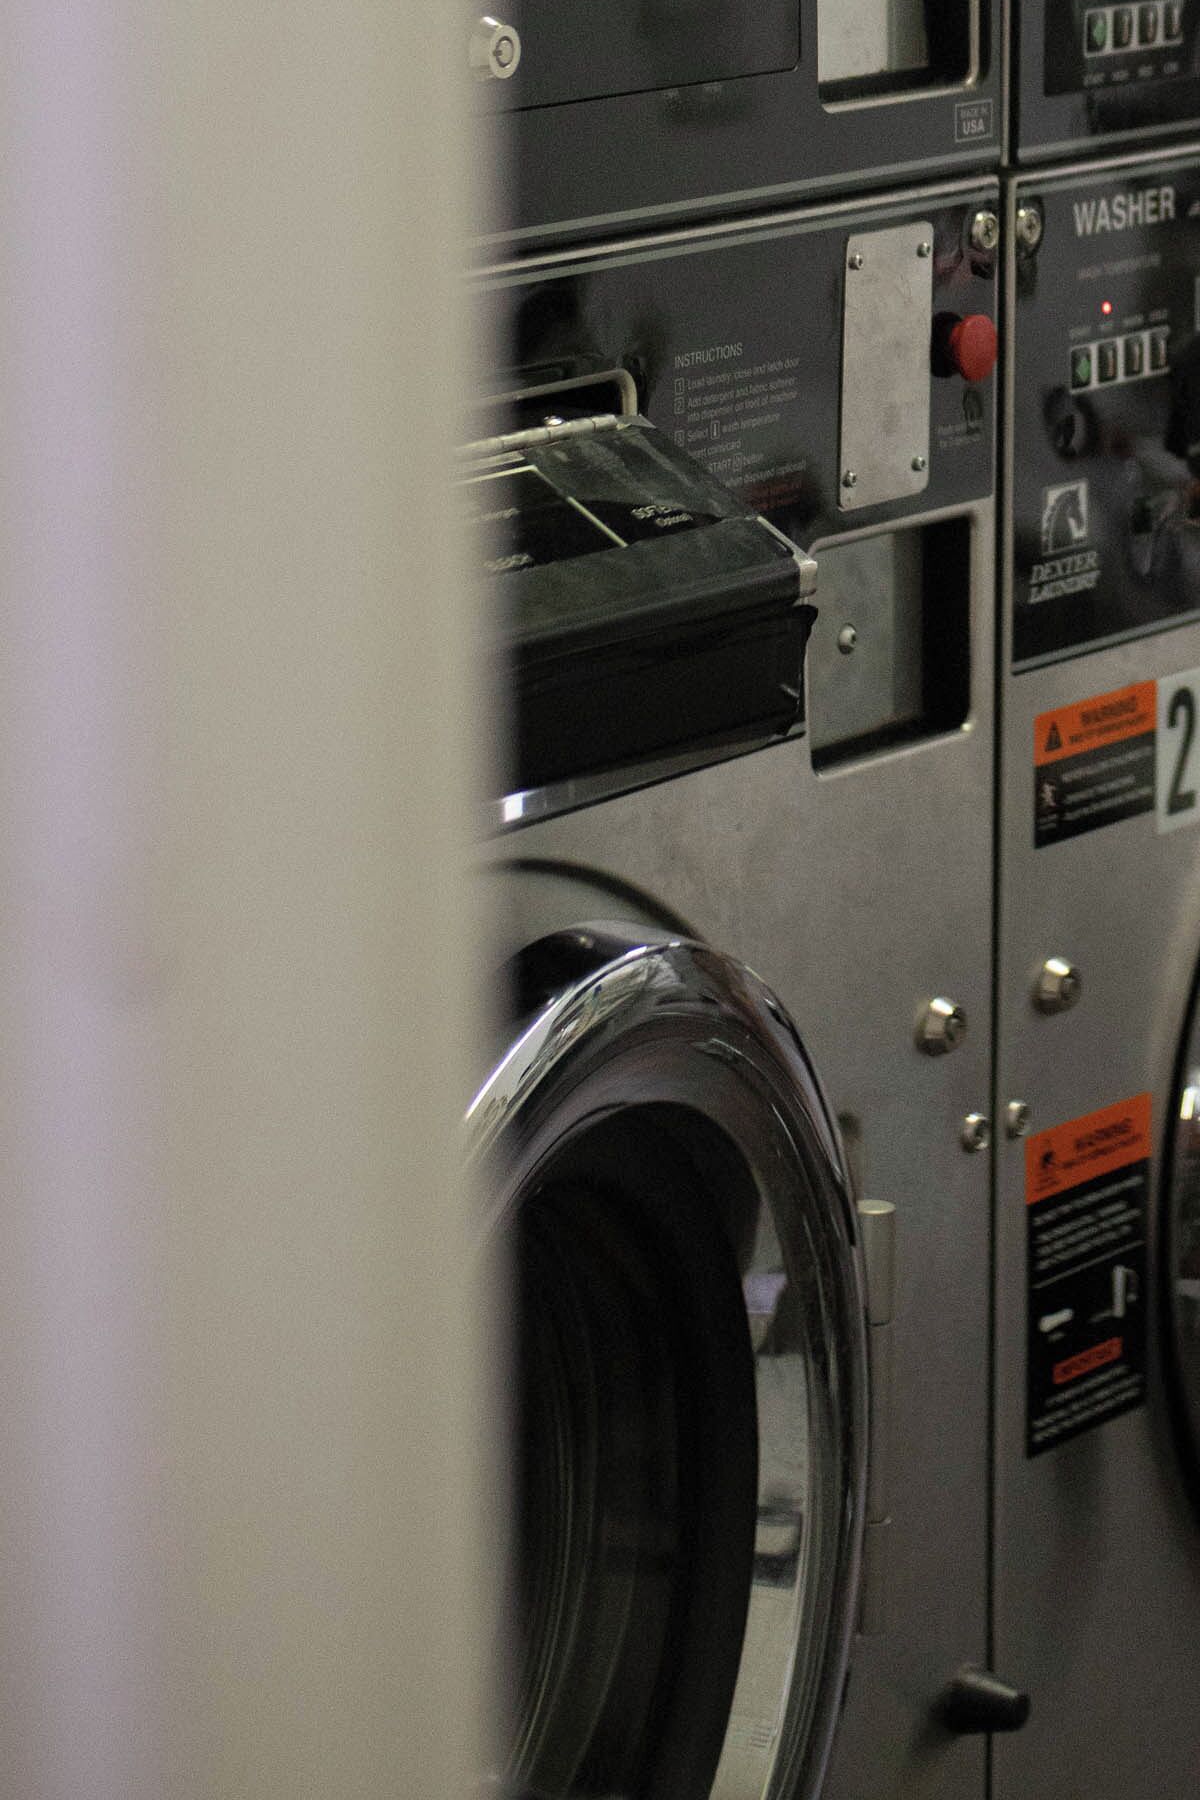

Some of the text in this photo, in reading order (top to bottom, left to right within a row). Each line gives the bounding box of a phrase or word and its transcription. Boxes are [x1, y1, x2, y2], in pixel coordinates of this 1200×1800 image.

[962, 118, 985, 136] USA
[1073, 186, 1176, 237] WASHER
[674, 342, 743, 369] INSTRUCTIONS
[1030, 550, 1097, 584] DEXTER
[1167, 686, 1196, 816] 2
